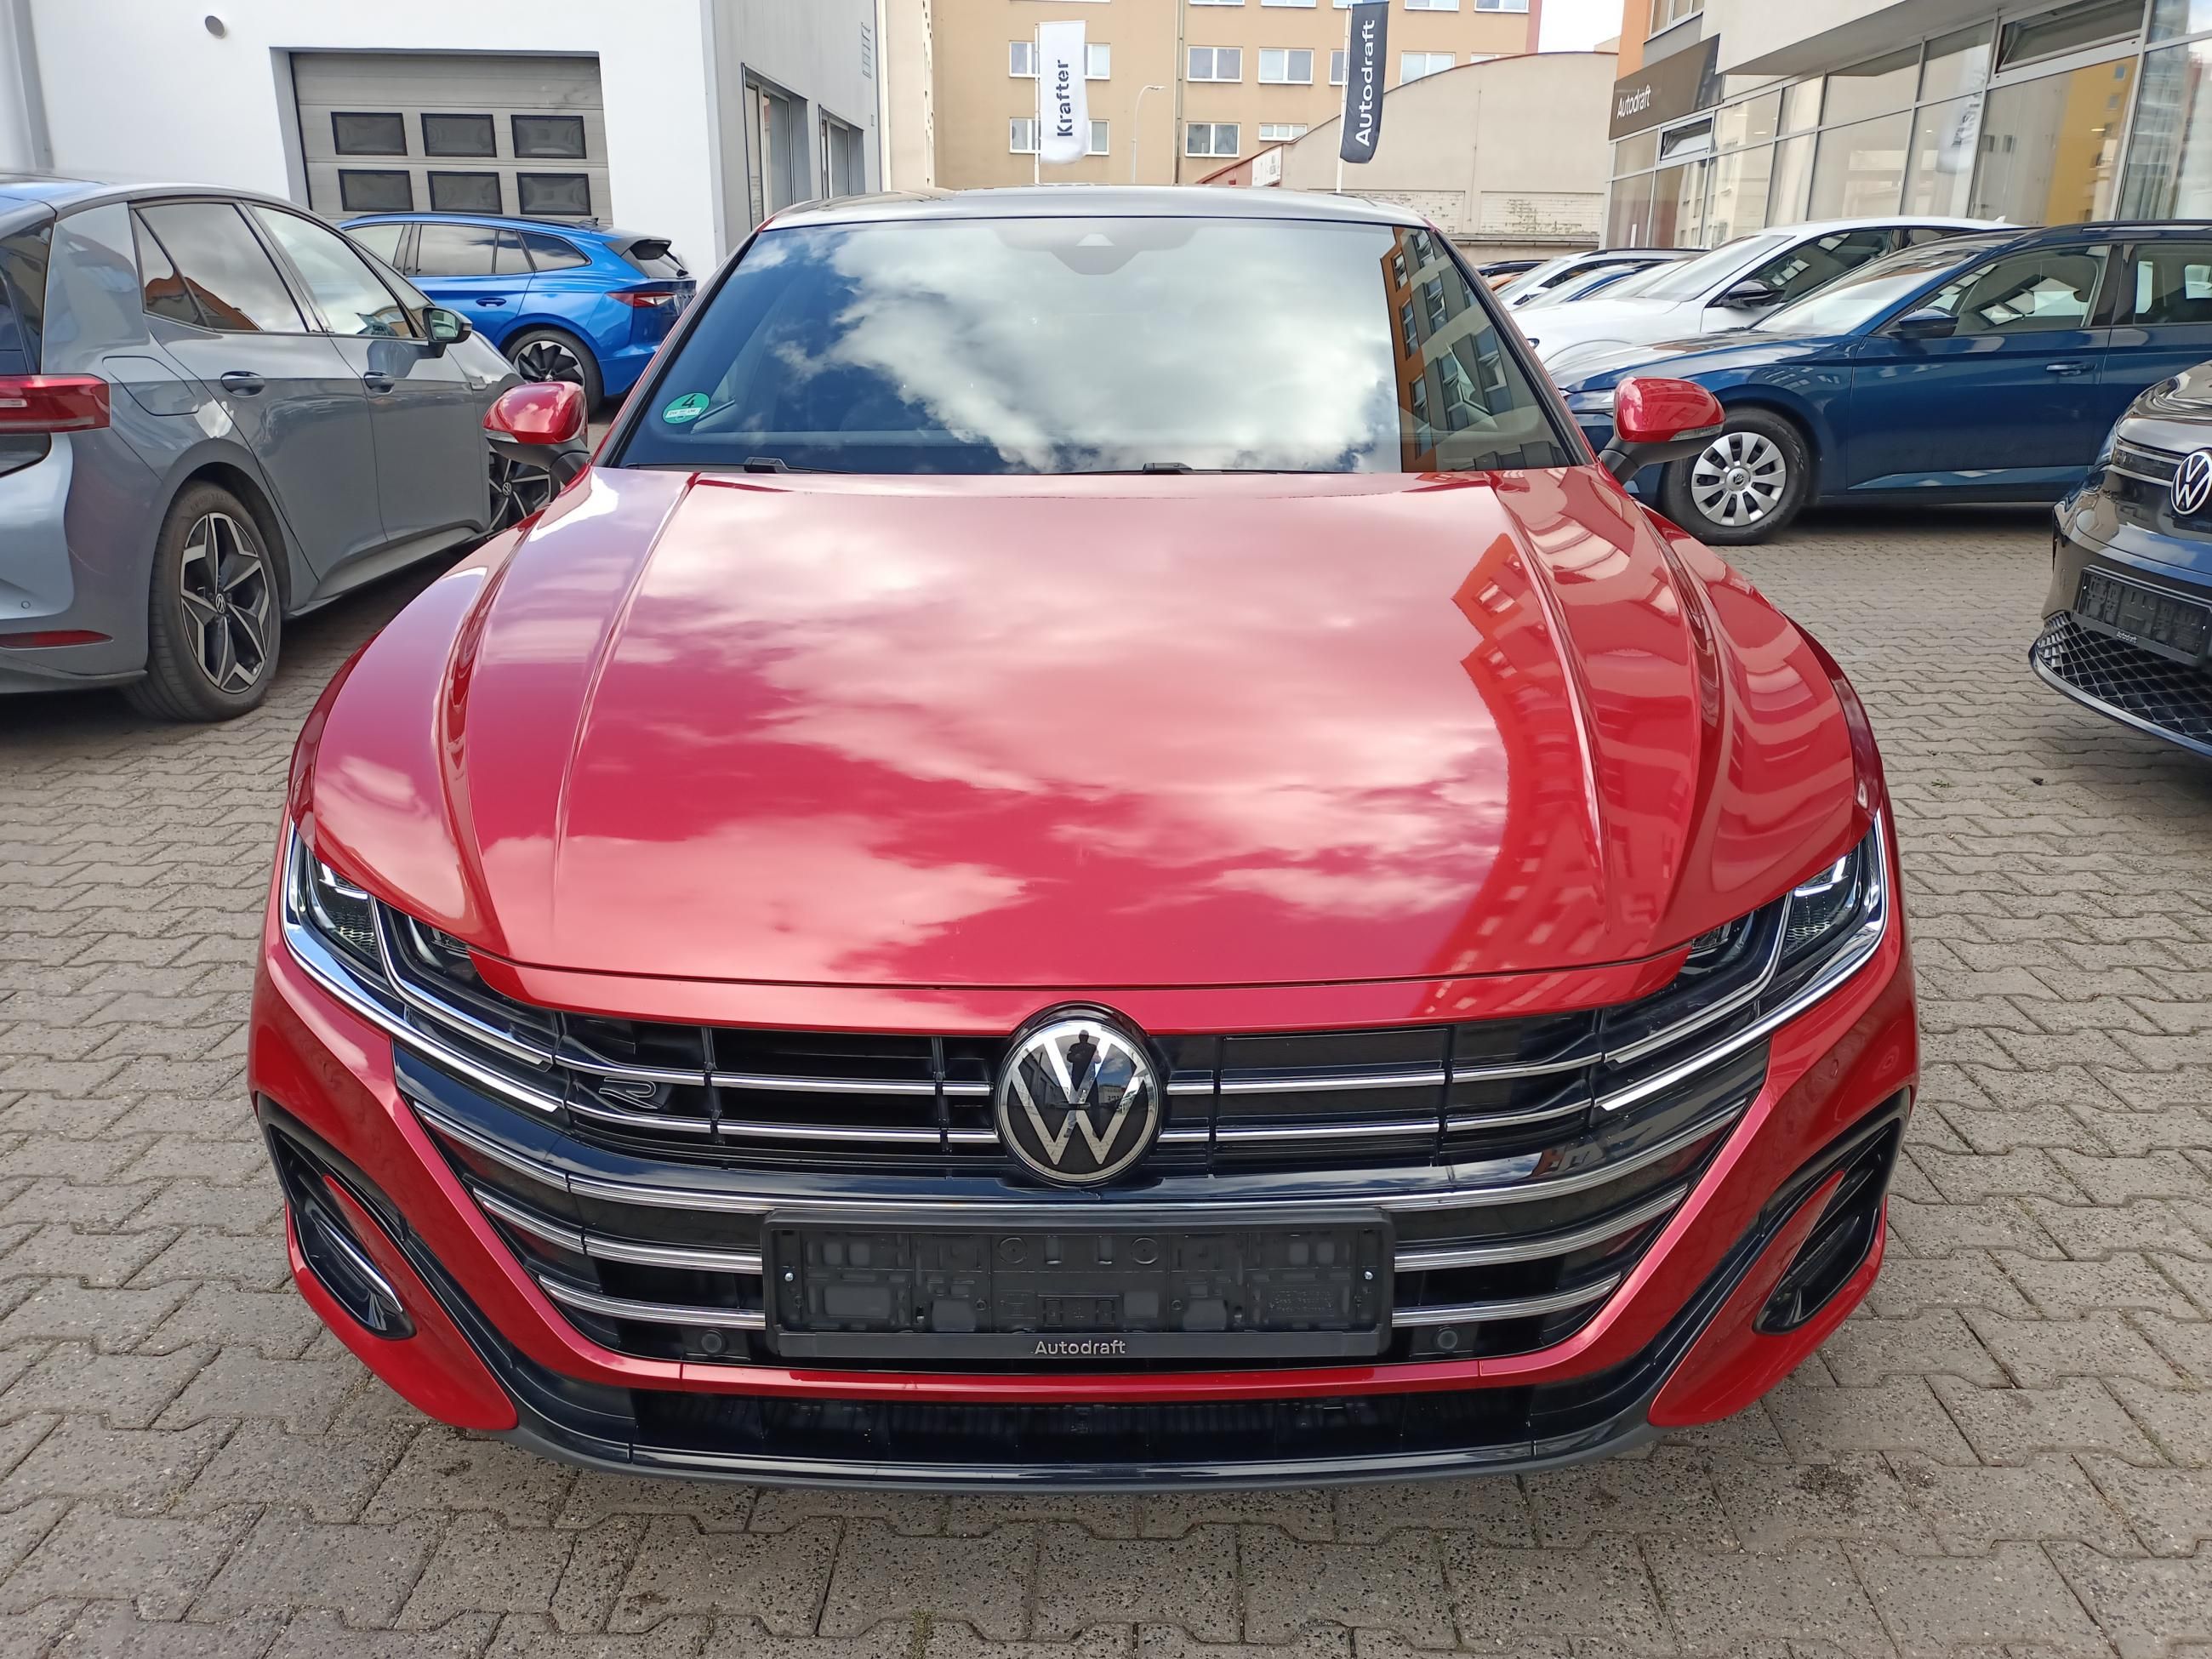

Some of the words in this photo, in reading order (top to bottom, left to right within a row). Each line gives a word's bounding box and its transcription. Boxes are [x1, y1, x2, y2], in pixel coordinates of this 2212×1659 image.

[1056, 59, 1073, 136] Krafter
[1355, 20, 1376, 147] Autodraft
[1616, 83, 1651, 120] Autodraft
[681, 393, 697, 408] 4
[1006, 1027, 1150, 1172] VW
[1034, 1339, 1126, 1355] Autodraft
